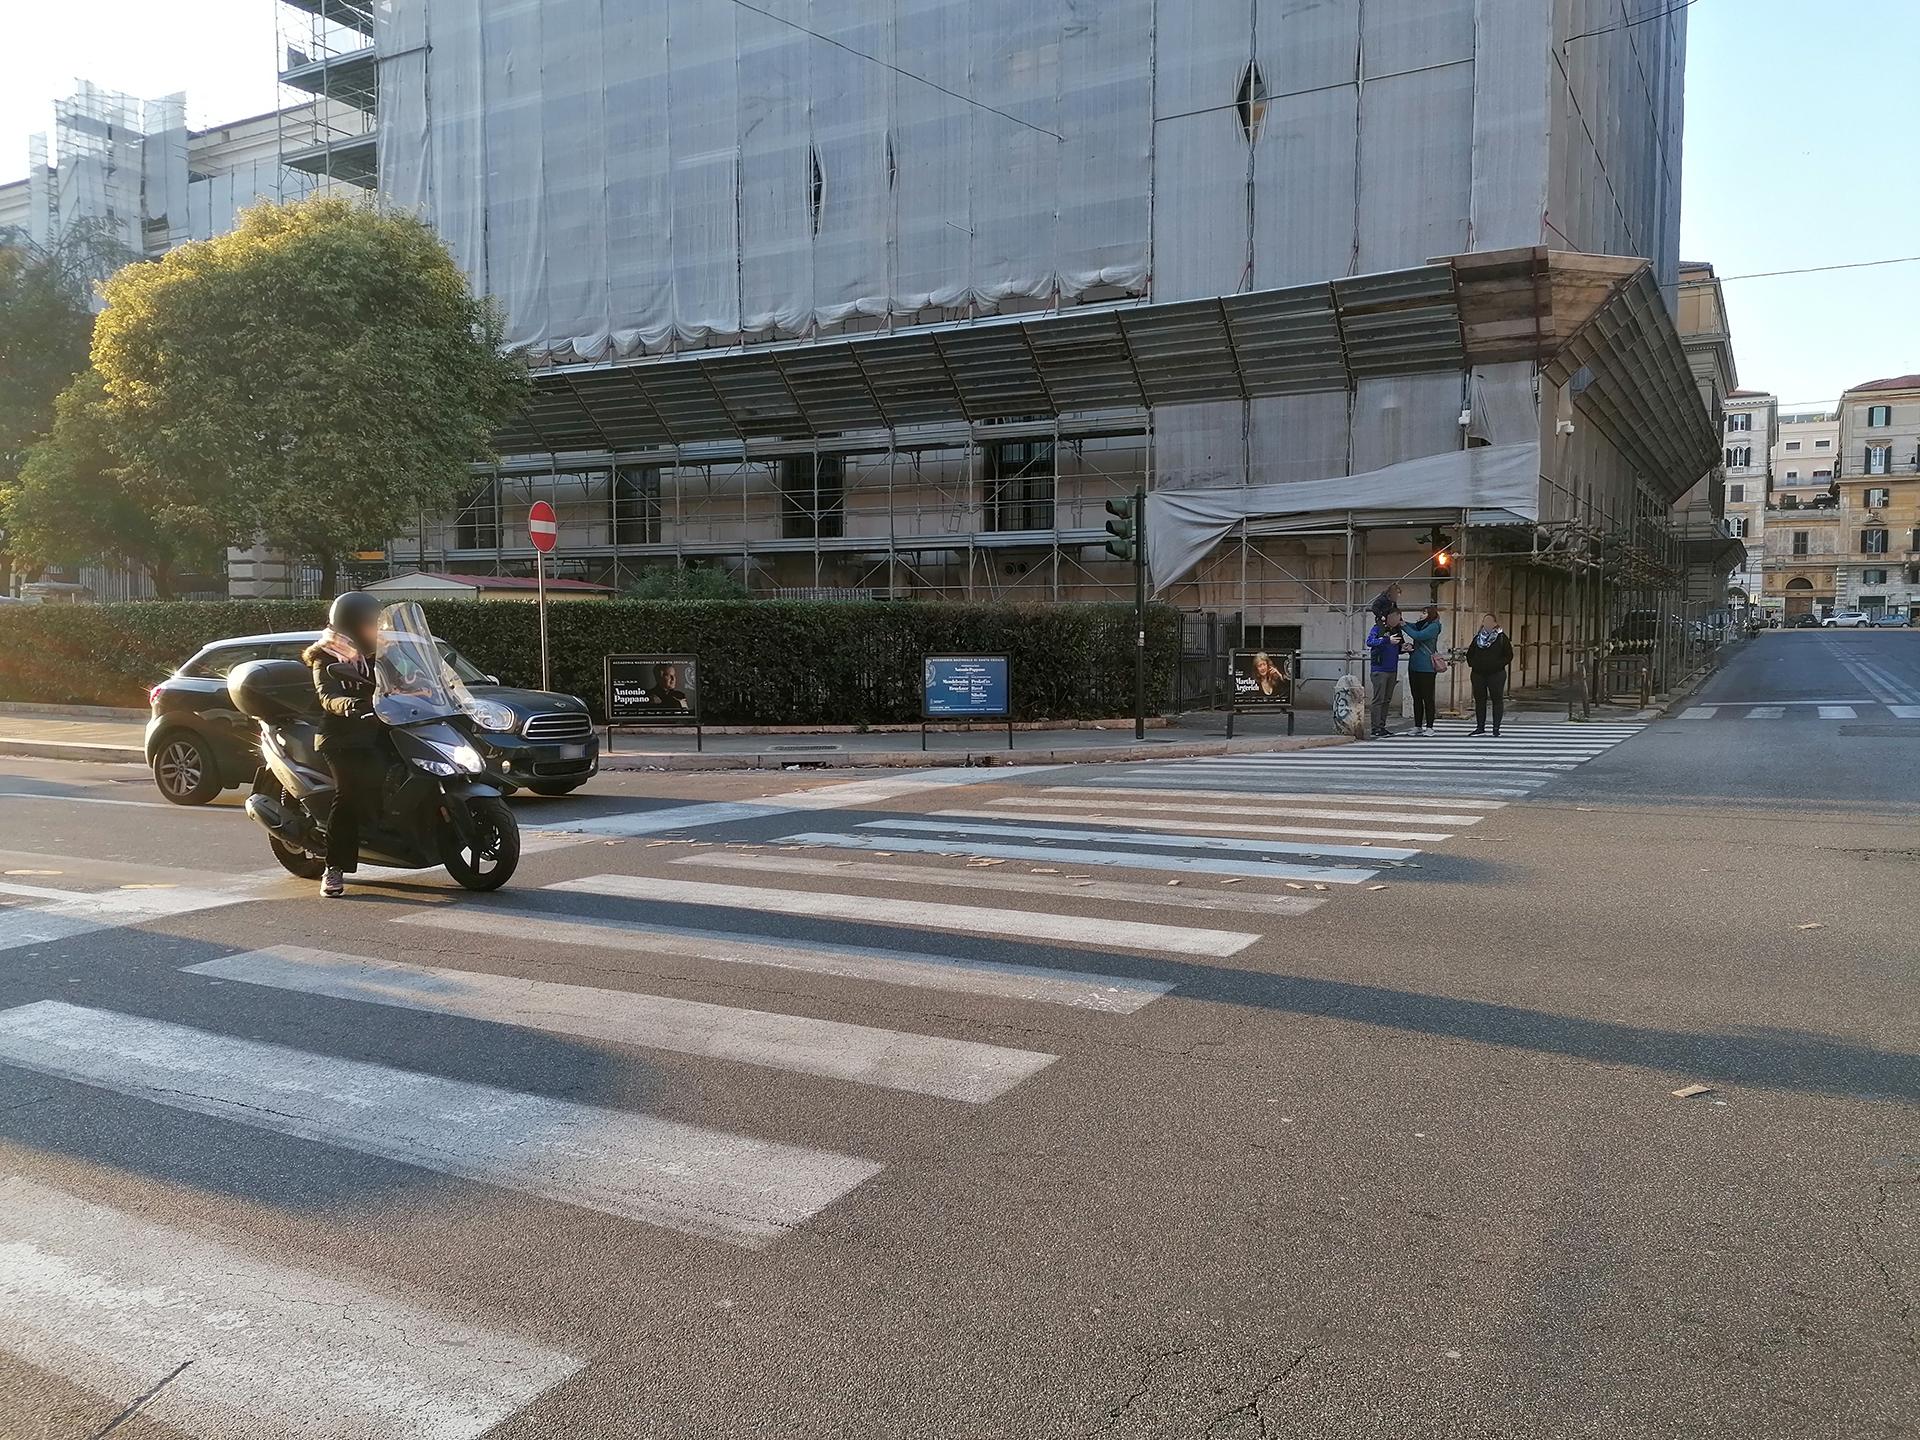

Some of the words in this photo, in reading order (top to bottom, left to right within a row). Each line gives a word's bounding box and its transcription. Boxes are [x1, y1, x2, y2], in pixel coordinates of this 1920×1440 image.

[1235, 677, 1256, 685] Martha
[614, 687, 646, 695] Antonio
[1235, 684, 1259, 692] Argerich
[614, 695, 650, 704] Pappano
